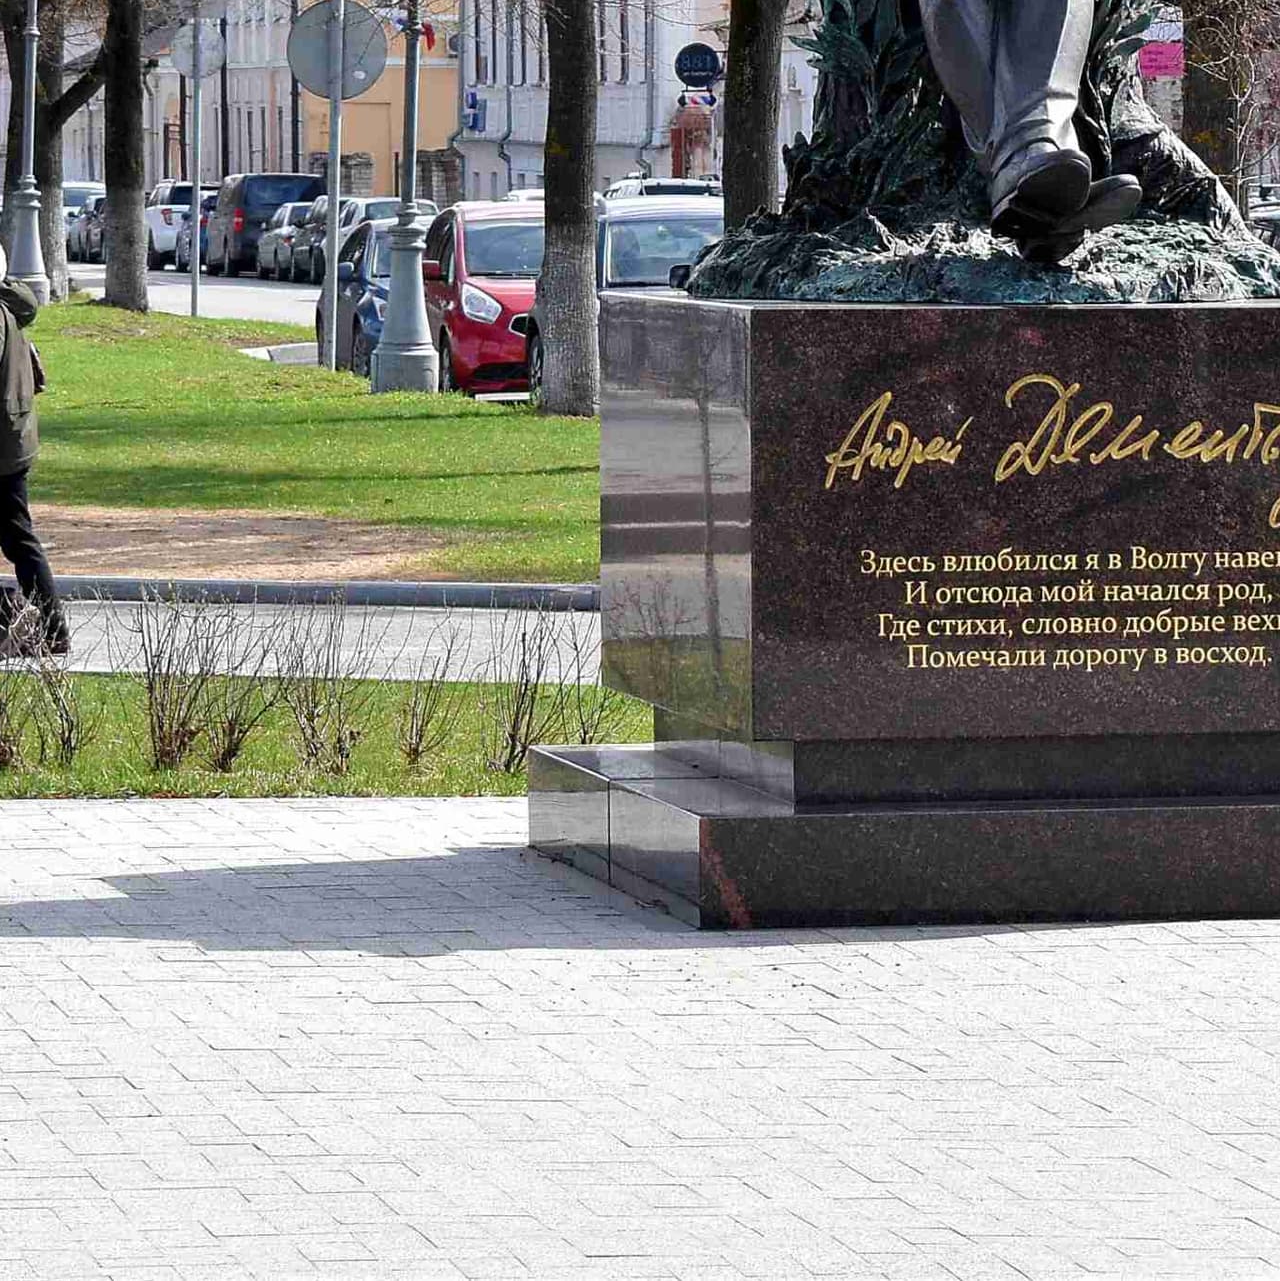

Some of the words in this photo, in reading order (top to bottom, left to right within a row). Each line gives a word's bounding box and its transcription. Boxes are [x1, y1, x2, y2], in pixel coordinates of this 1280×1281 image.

[825, 391, 974, 489] Андрей
[860, 549, 936, 578] Здесь
[942, 546, 1078, 573] влюбился
[1086, 553, 1099, 571] я
[1107, 552, 1122, 570] в
[1130, 546, 1207, 576] Волгу
[904, 580, 928, 605] И
[935, 585, 1033, 608] отсюда
[1040, 579, 1095, 603] мой
[1103, 583, 1211, 602] начался
[1217, 582, 1273, 608] род,
[877, 613, 921, 641] Где
[926, 618, 1014, 638] стихи,
[1021, 615, 1118, 635] словно
[1123, 608, 1226, 640] добрые
[906, 644, 1046, 669] Помечали
[1053, 647, 1148, 672] дорогу
[1154, 647, 1168, 665] в
[1175, 645, 1273, 668] восход.
